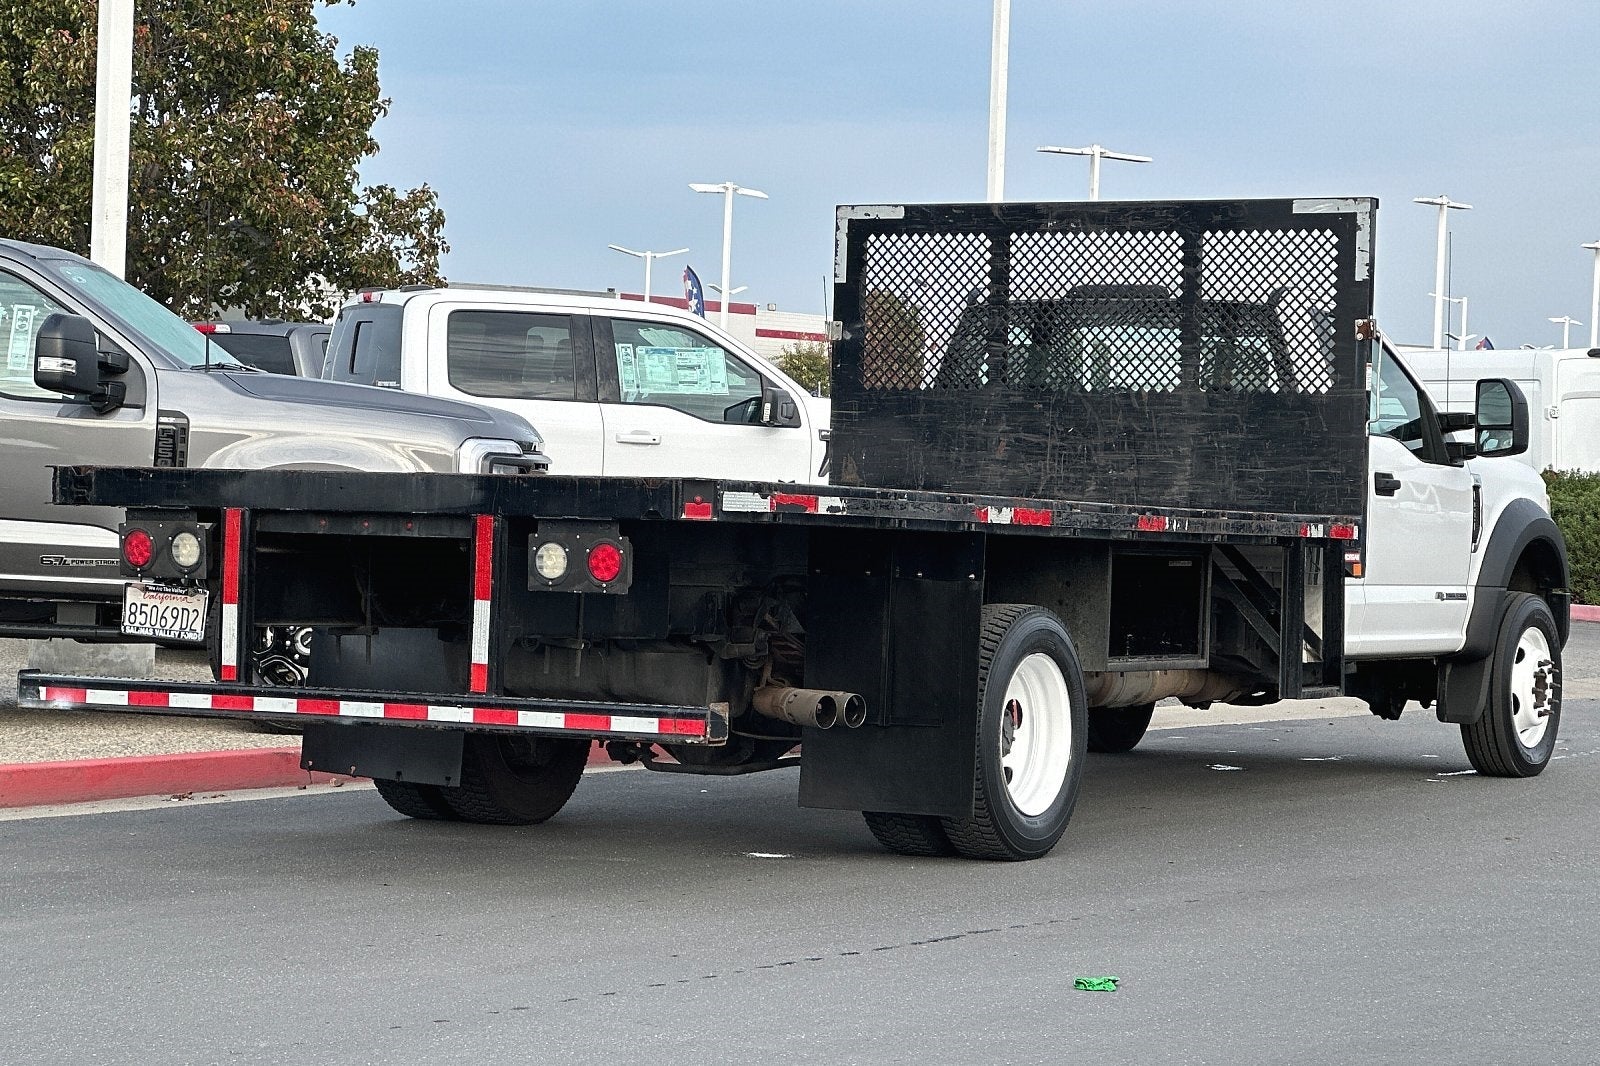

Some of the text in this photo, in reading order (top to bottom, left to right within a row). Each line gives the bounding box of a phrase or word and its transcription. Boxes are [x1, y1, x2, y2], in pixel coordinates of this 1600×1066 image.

[143, 591, 193, 604] California
[128, 602, 200, 632] 85069D2
[125, 625, 198, 640] SALINAS VALLEY FORD
